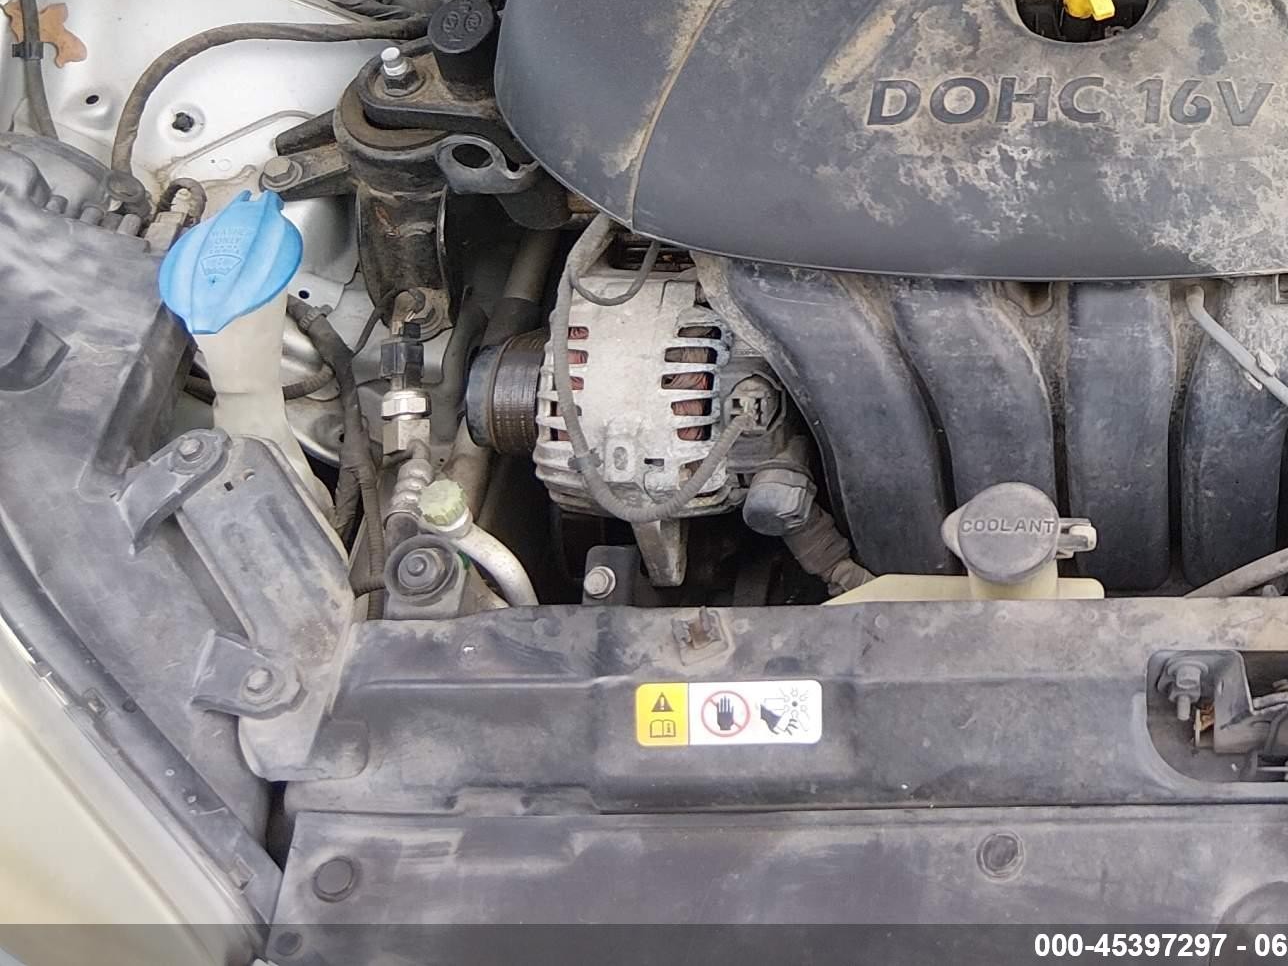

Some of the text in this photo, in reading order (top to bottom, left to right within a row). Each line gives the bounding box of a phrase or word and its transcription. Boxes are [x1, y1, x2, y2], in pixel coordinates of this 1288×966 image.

[866, 76, 1274, 127] DOHC 16V
[961, 518, 1055, 533] COOLANT
